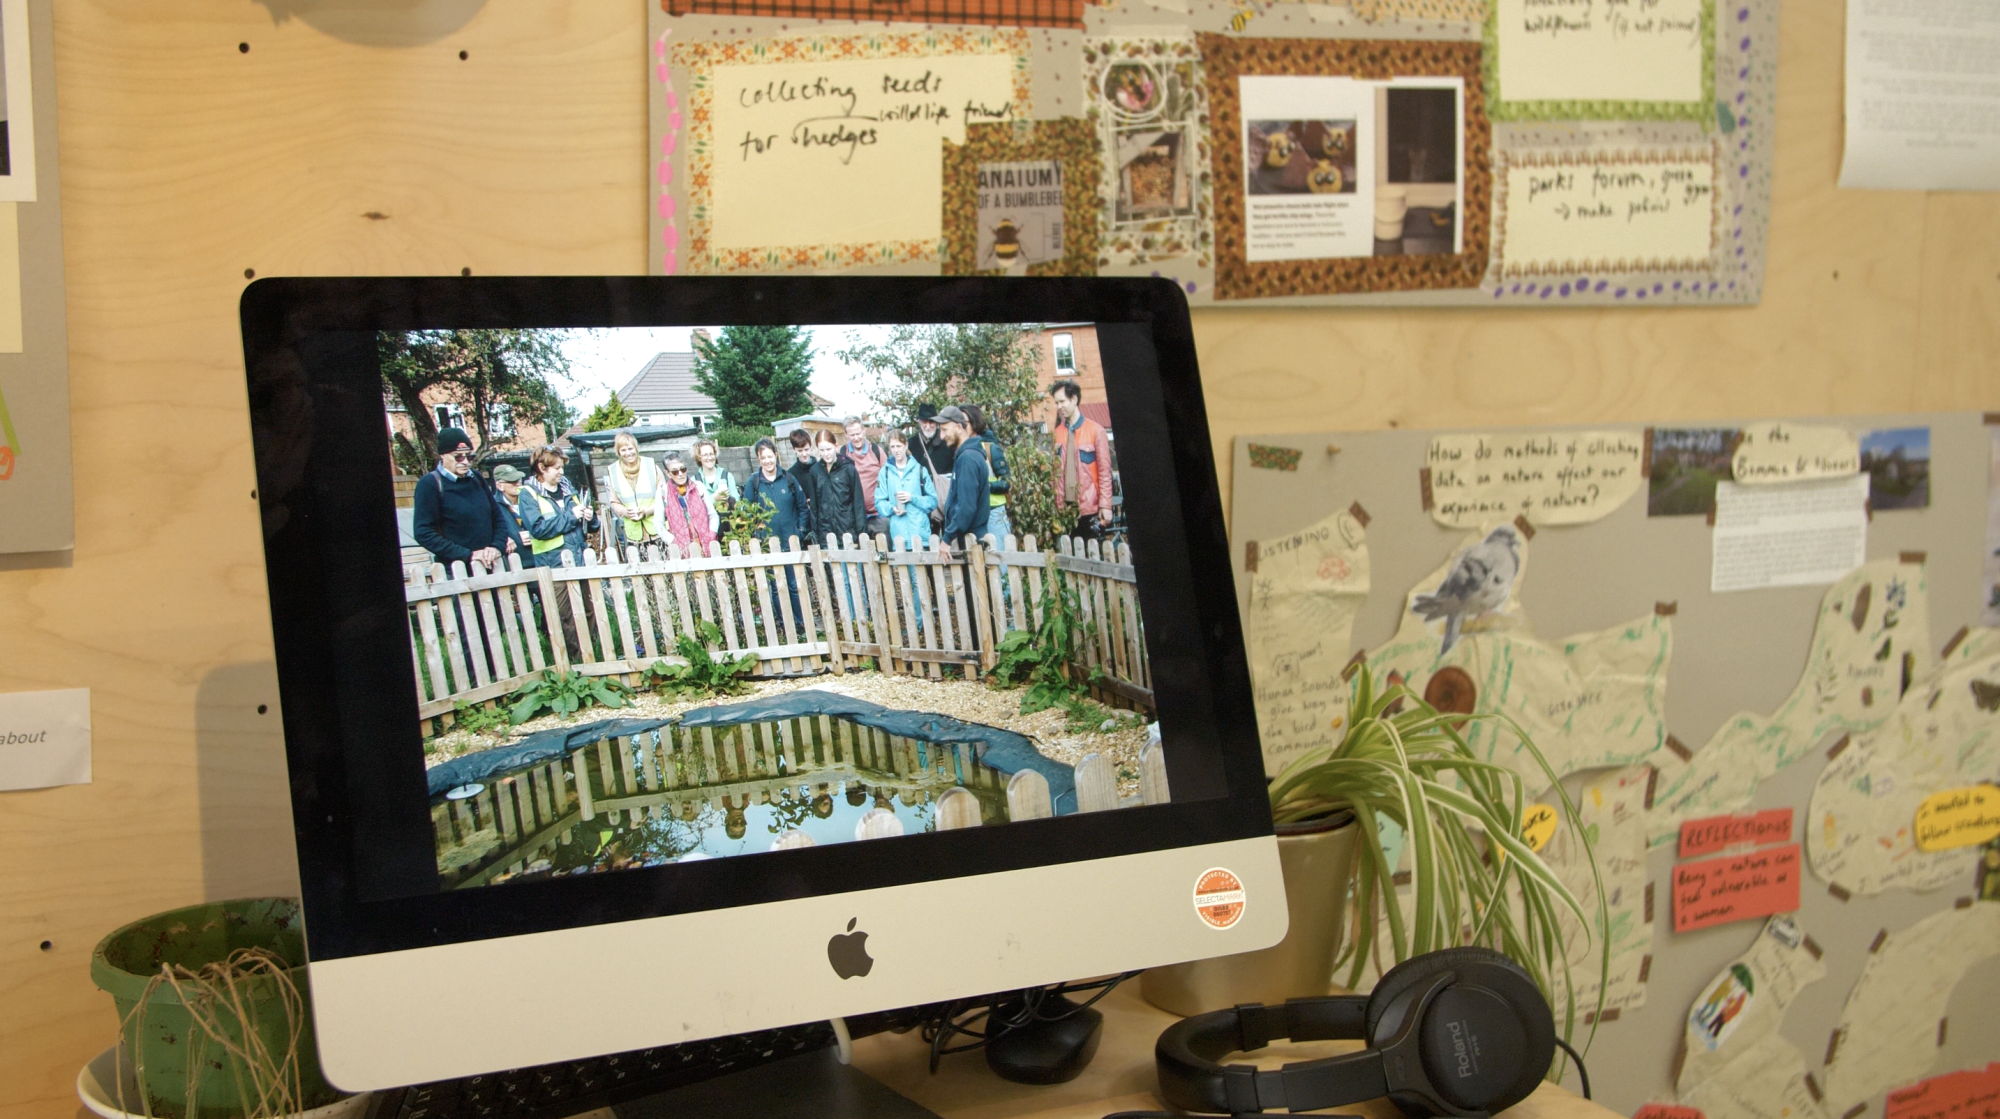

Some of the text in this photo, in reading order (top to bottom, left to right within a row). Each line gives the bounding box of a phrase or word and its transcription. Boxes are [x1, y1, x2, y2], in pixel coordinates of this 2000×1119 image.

[740, 70, 943, 116] collecting seeds
[740, 124, 878, 165] for hedges
[978, 193, 990, 209] OF
[994, 193, 1001, 208] A
[1529, 171, 1574, 203] parks
[1430, 440, 1463, 462] How
[1475, 439, 1492, 460] do
[1503, 437, 1558, 459] methods
[1435, 470, 1466, 488] data
[1503, 469, 1545, 482] nature
[0, 730, 46, 745] about
[1686, 818, 1790, 848] REFLECTIONS
[1446, 1021, 1472, 1078] Roland
